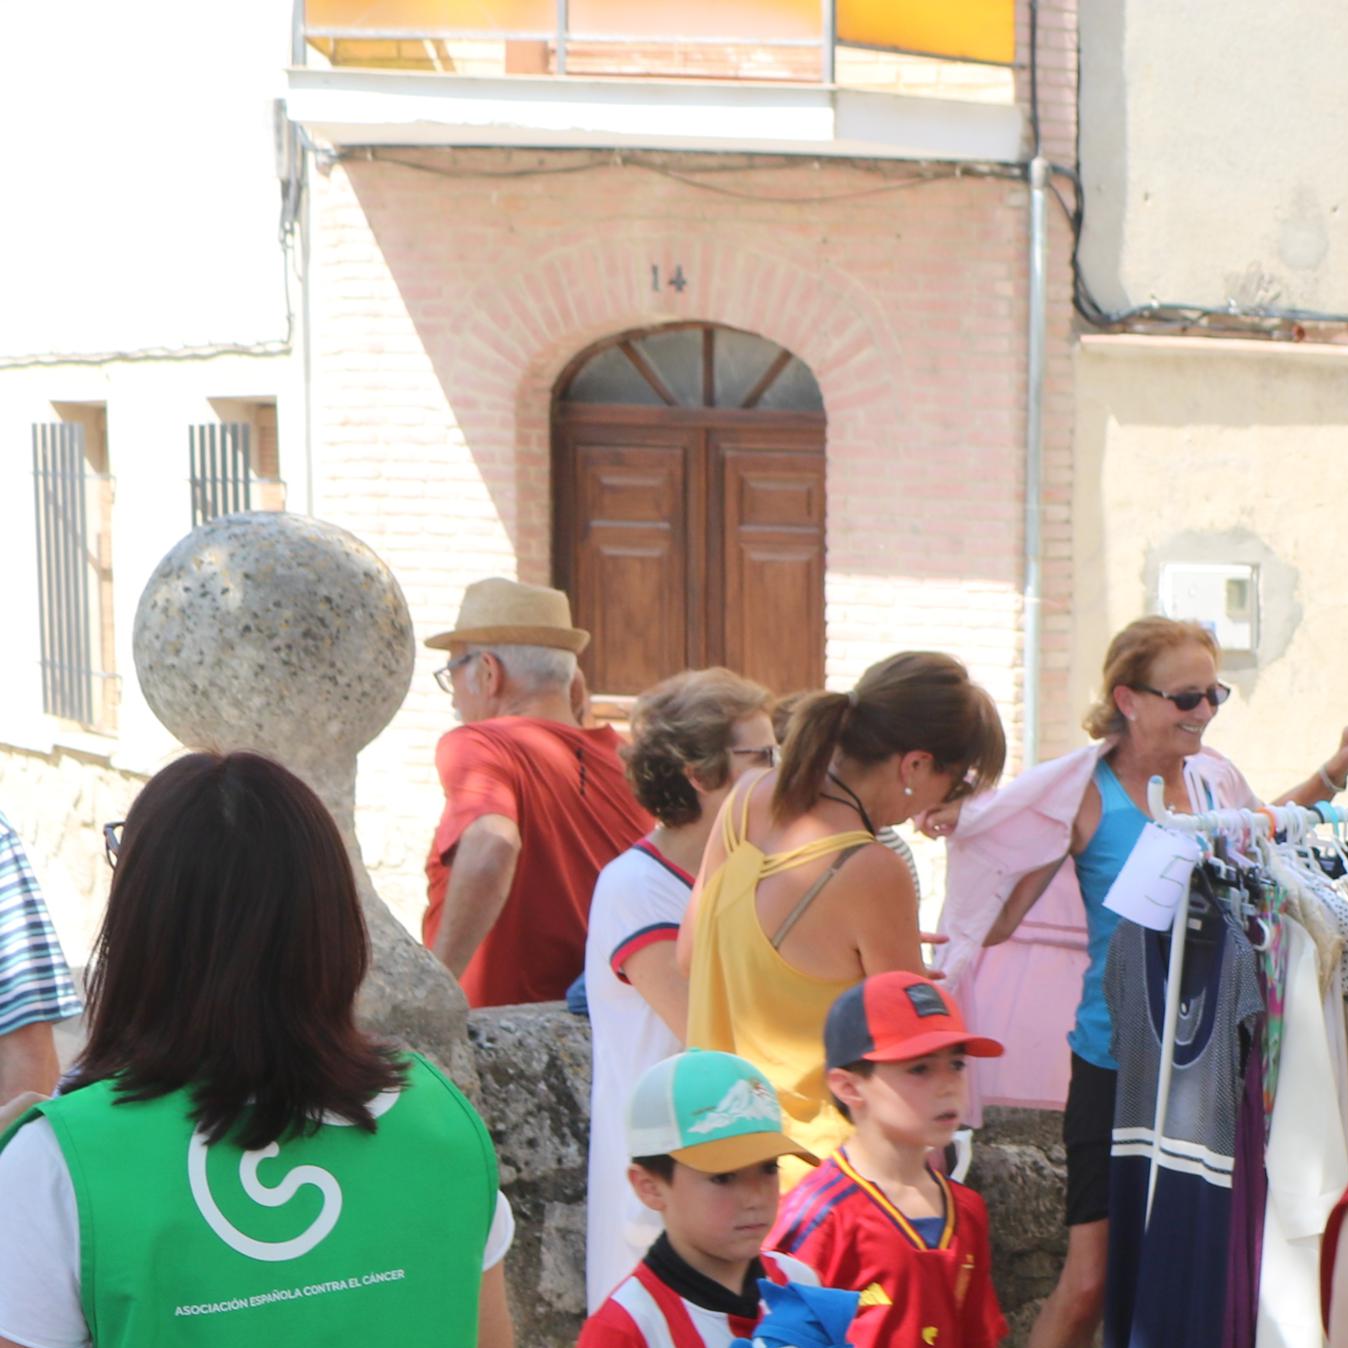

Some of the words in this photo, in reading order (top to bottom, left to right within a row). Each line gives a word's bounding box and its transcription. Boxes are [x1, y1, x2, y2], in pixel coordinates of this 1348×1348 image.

[651, 263, 688, 292] 14
[174, 1298, 248, 1316] ASOCIACIÓN
[248, 1287, 303, 1307] ESPAÑOLA
[303, 1280, 348, 1297] CONTRA
[348, 1277, 363, 1289] EL
[362, 1268, 405, 1285] CÁNCER
